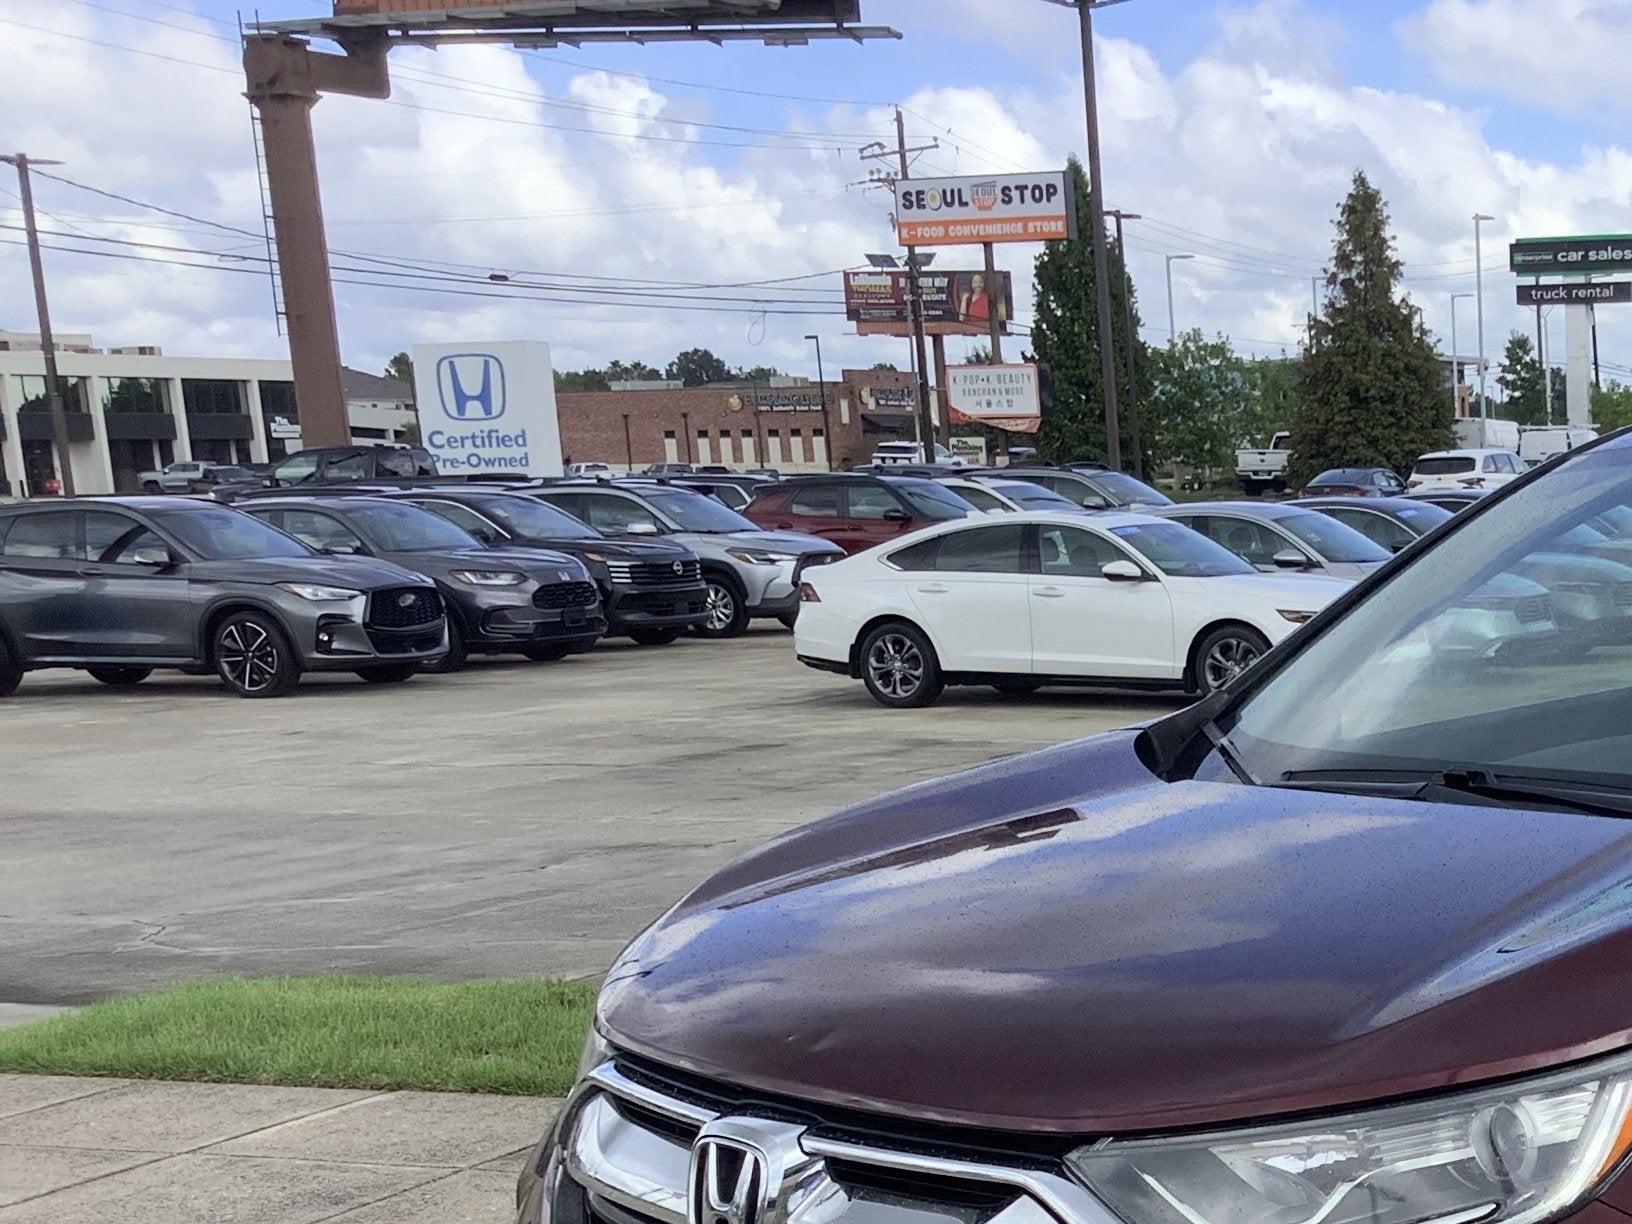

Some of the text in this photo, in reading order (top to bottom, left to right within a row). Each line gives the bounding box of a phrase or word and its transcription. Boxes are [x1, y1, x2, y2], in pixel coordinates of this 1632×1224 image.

[902, 183, 1058, 211] SEOUL STOP
[901, 220, 1065, 239] K-FOOD CONVENIENCE STORE
[1557, 249, 1585, 262] car
[1588, 246, 1632, 261] sales
[1530, 285, 1614, 300] truck rental
[428, 428, 528, 450] Certified
[431, 452, 529, 468] Pre-Owned
